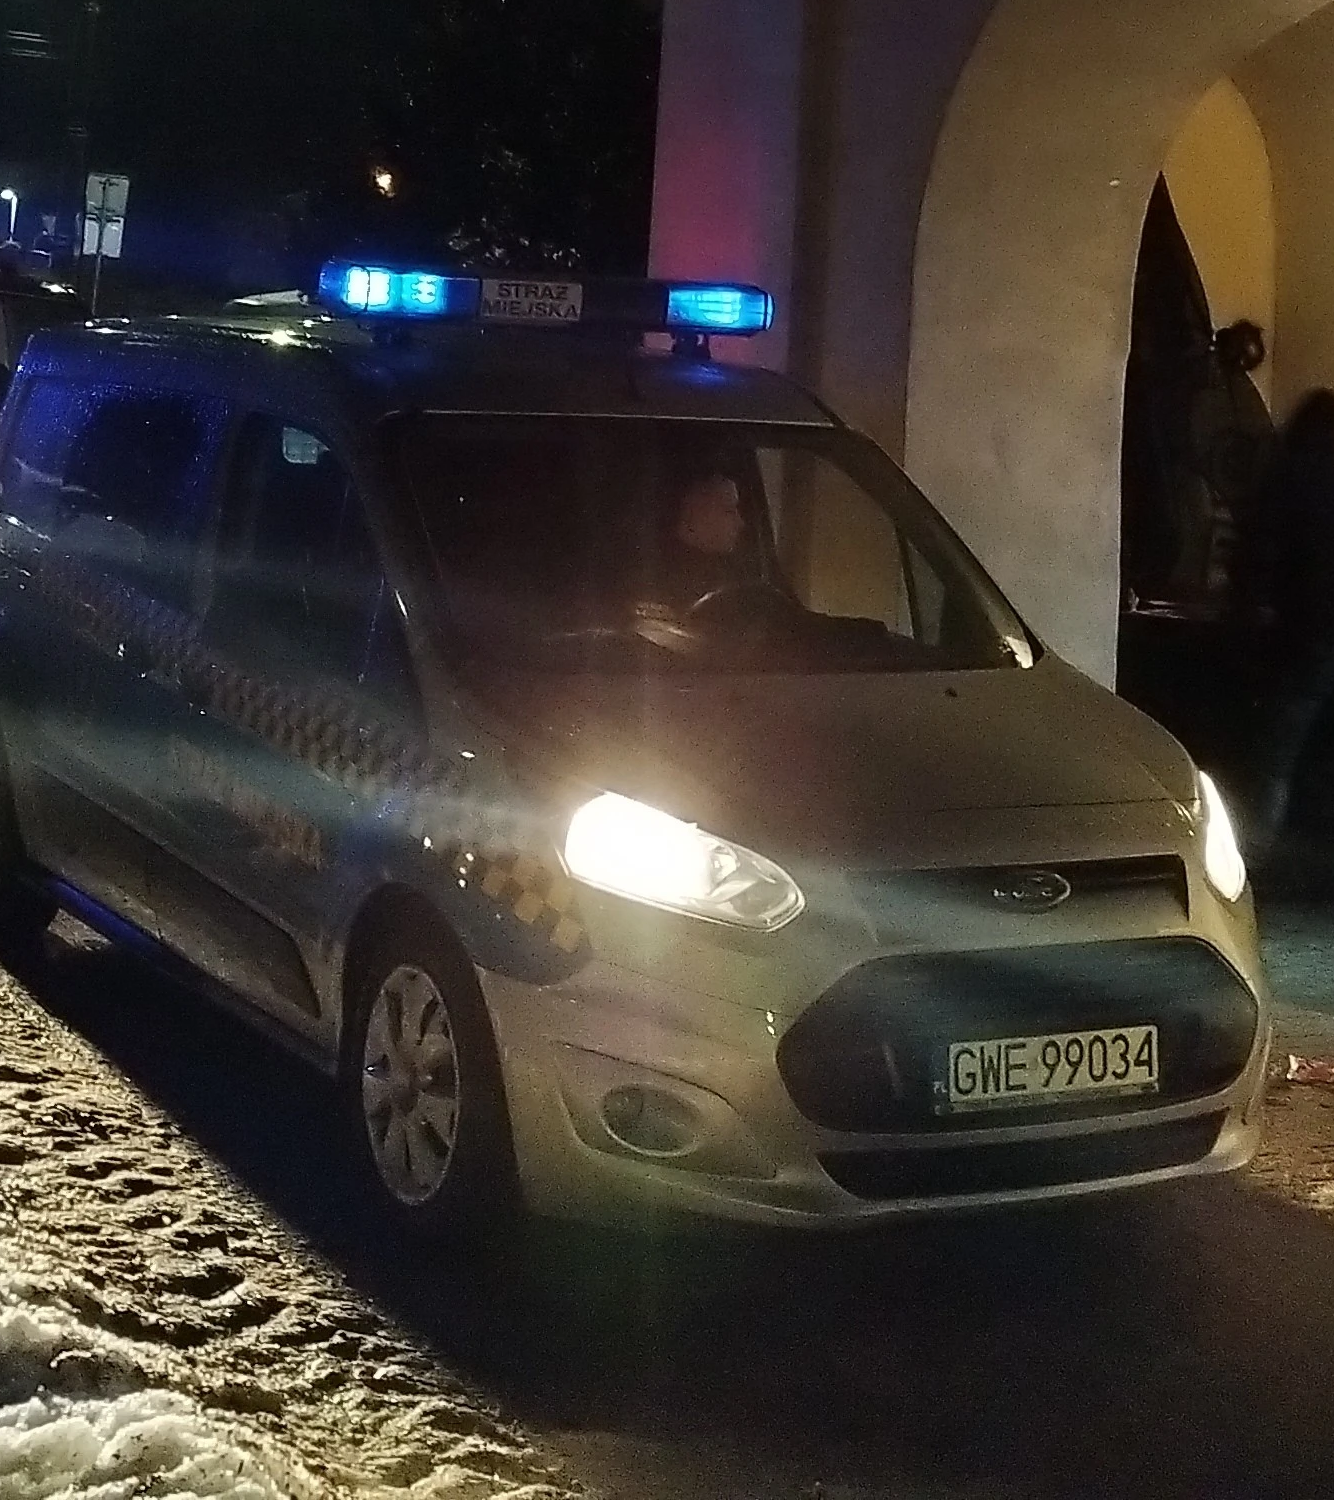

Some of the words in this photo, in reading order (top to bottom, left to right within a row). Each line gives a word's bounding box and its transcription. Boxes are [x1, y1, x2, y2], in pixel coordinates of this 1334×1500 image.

[482, 299, 579, 319] MIEJSKA
[953, 1043, 1028, 1096] GWE
[1041, 1030, 1155, 1088] 99034
